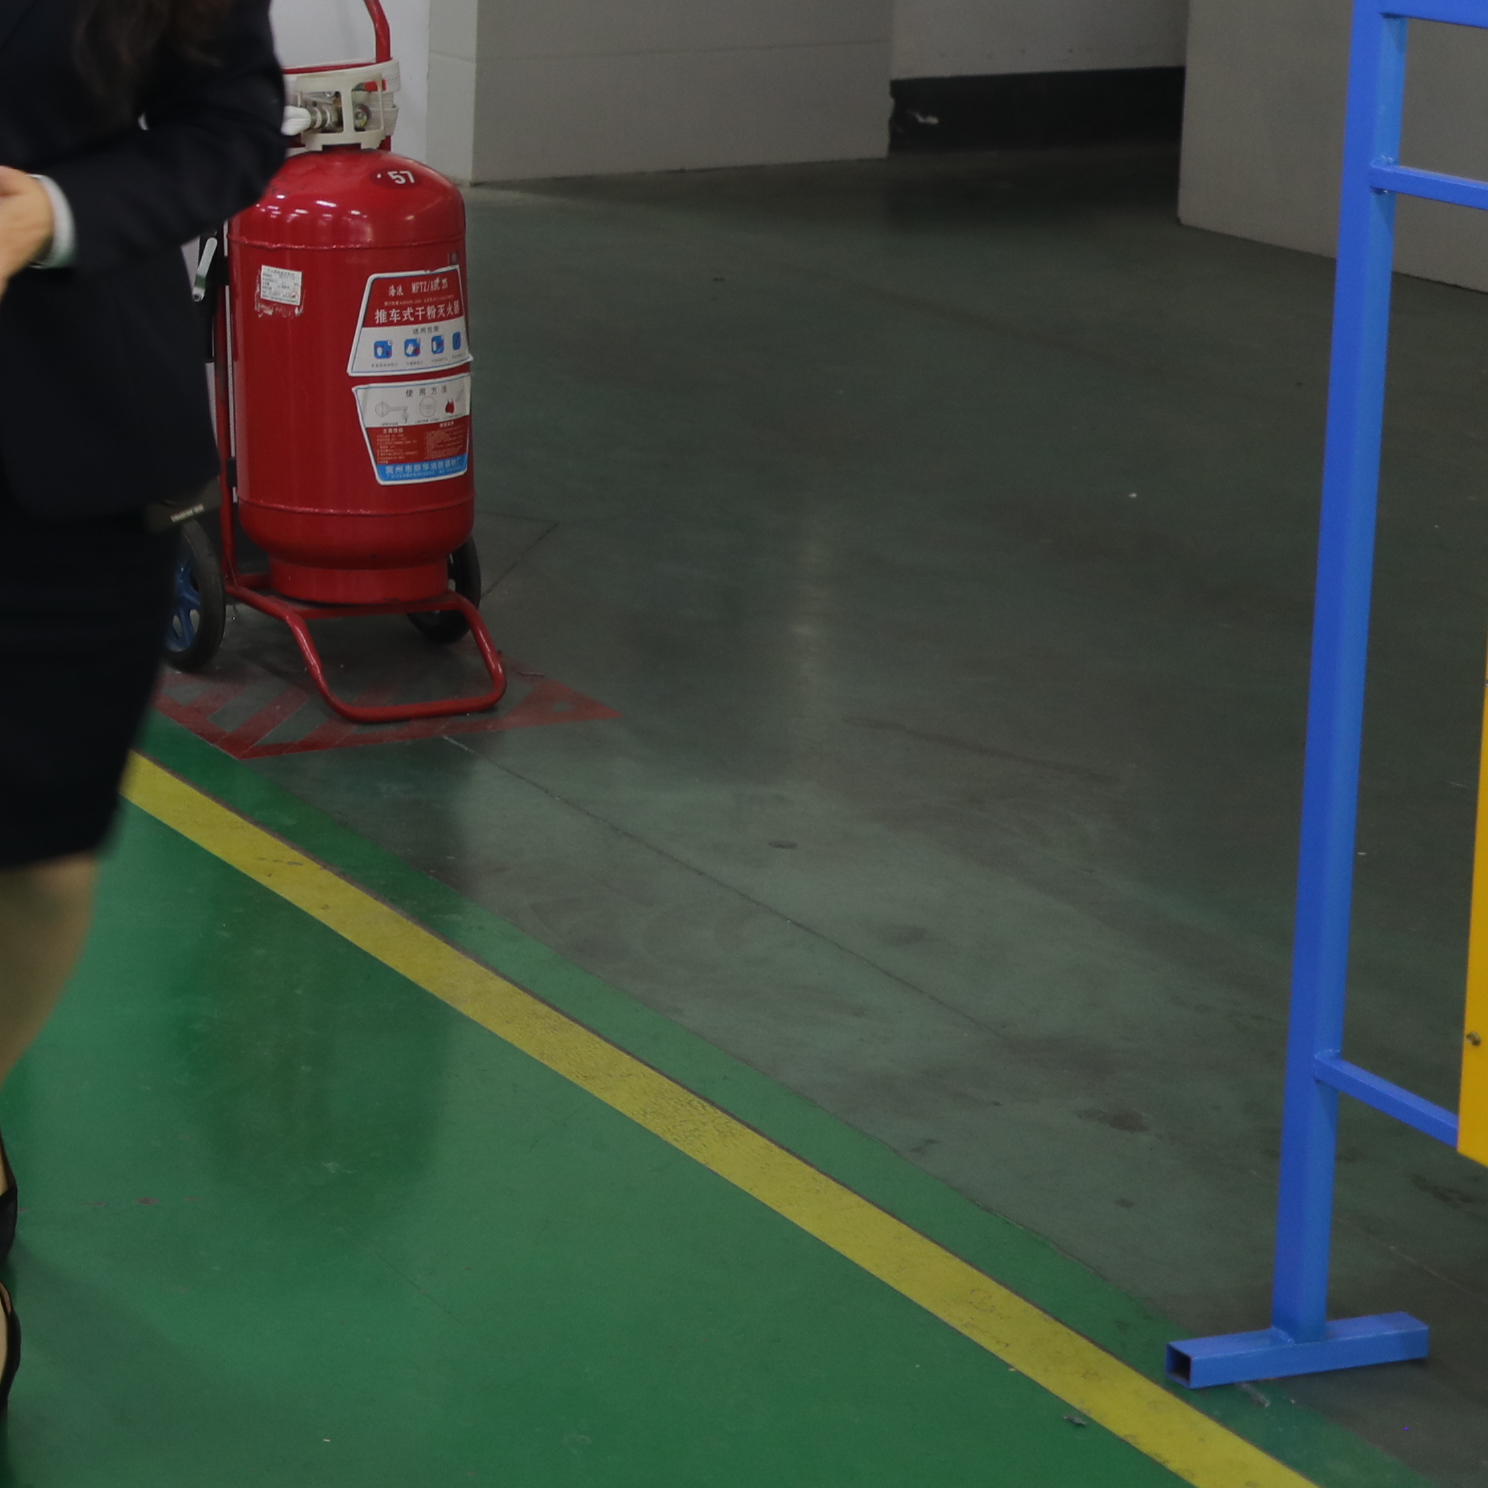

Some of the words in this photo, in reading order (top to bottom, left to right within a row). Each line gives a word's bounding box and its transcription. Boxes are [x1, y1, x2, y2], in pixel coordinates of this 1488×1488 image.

[387, 170, 415, 185] 57
[374, 299, 461, 325] 推车式干粉灭火器
